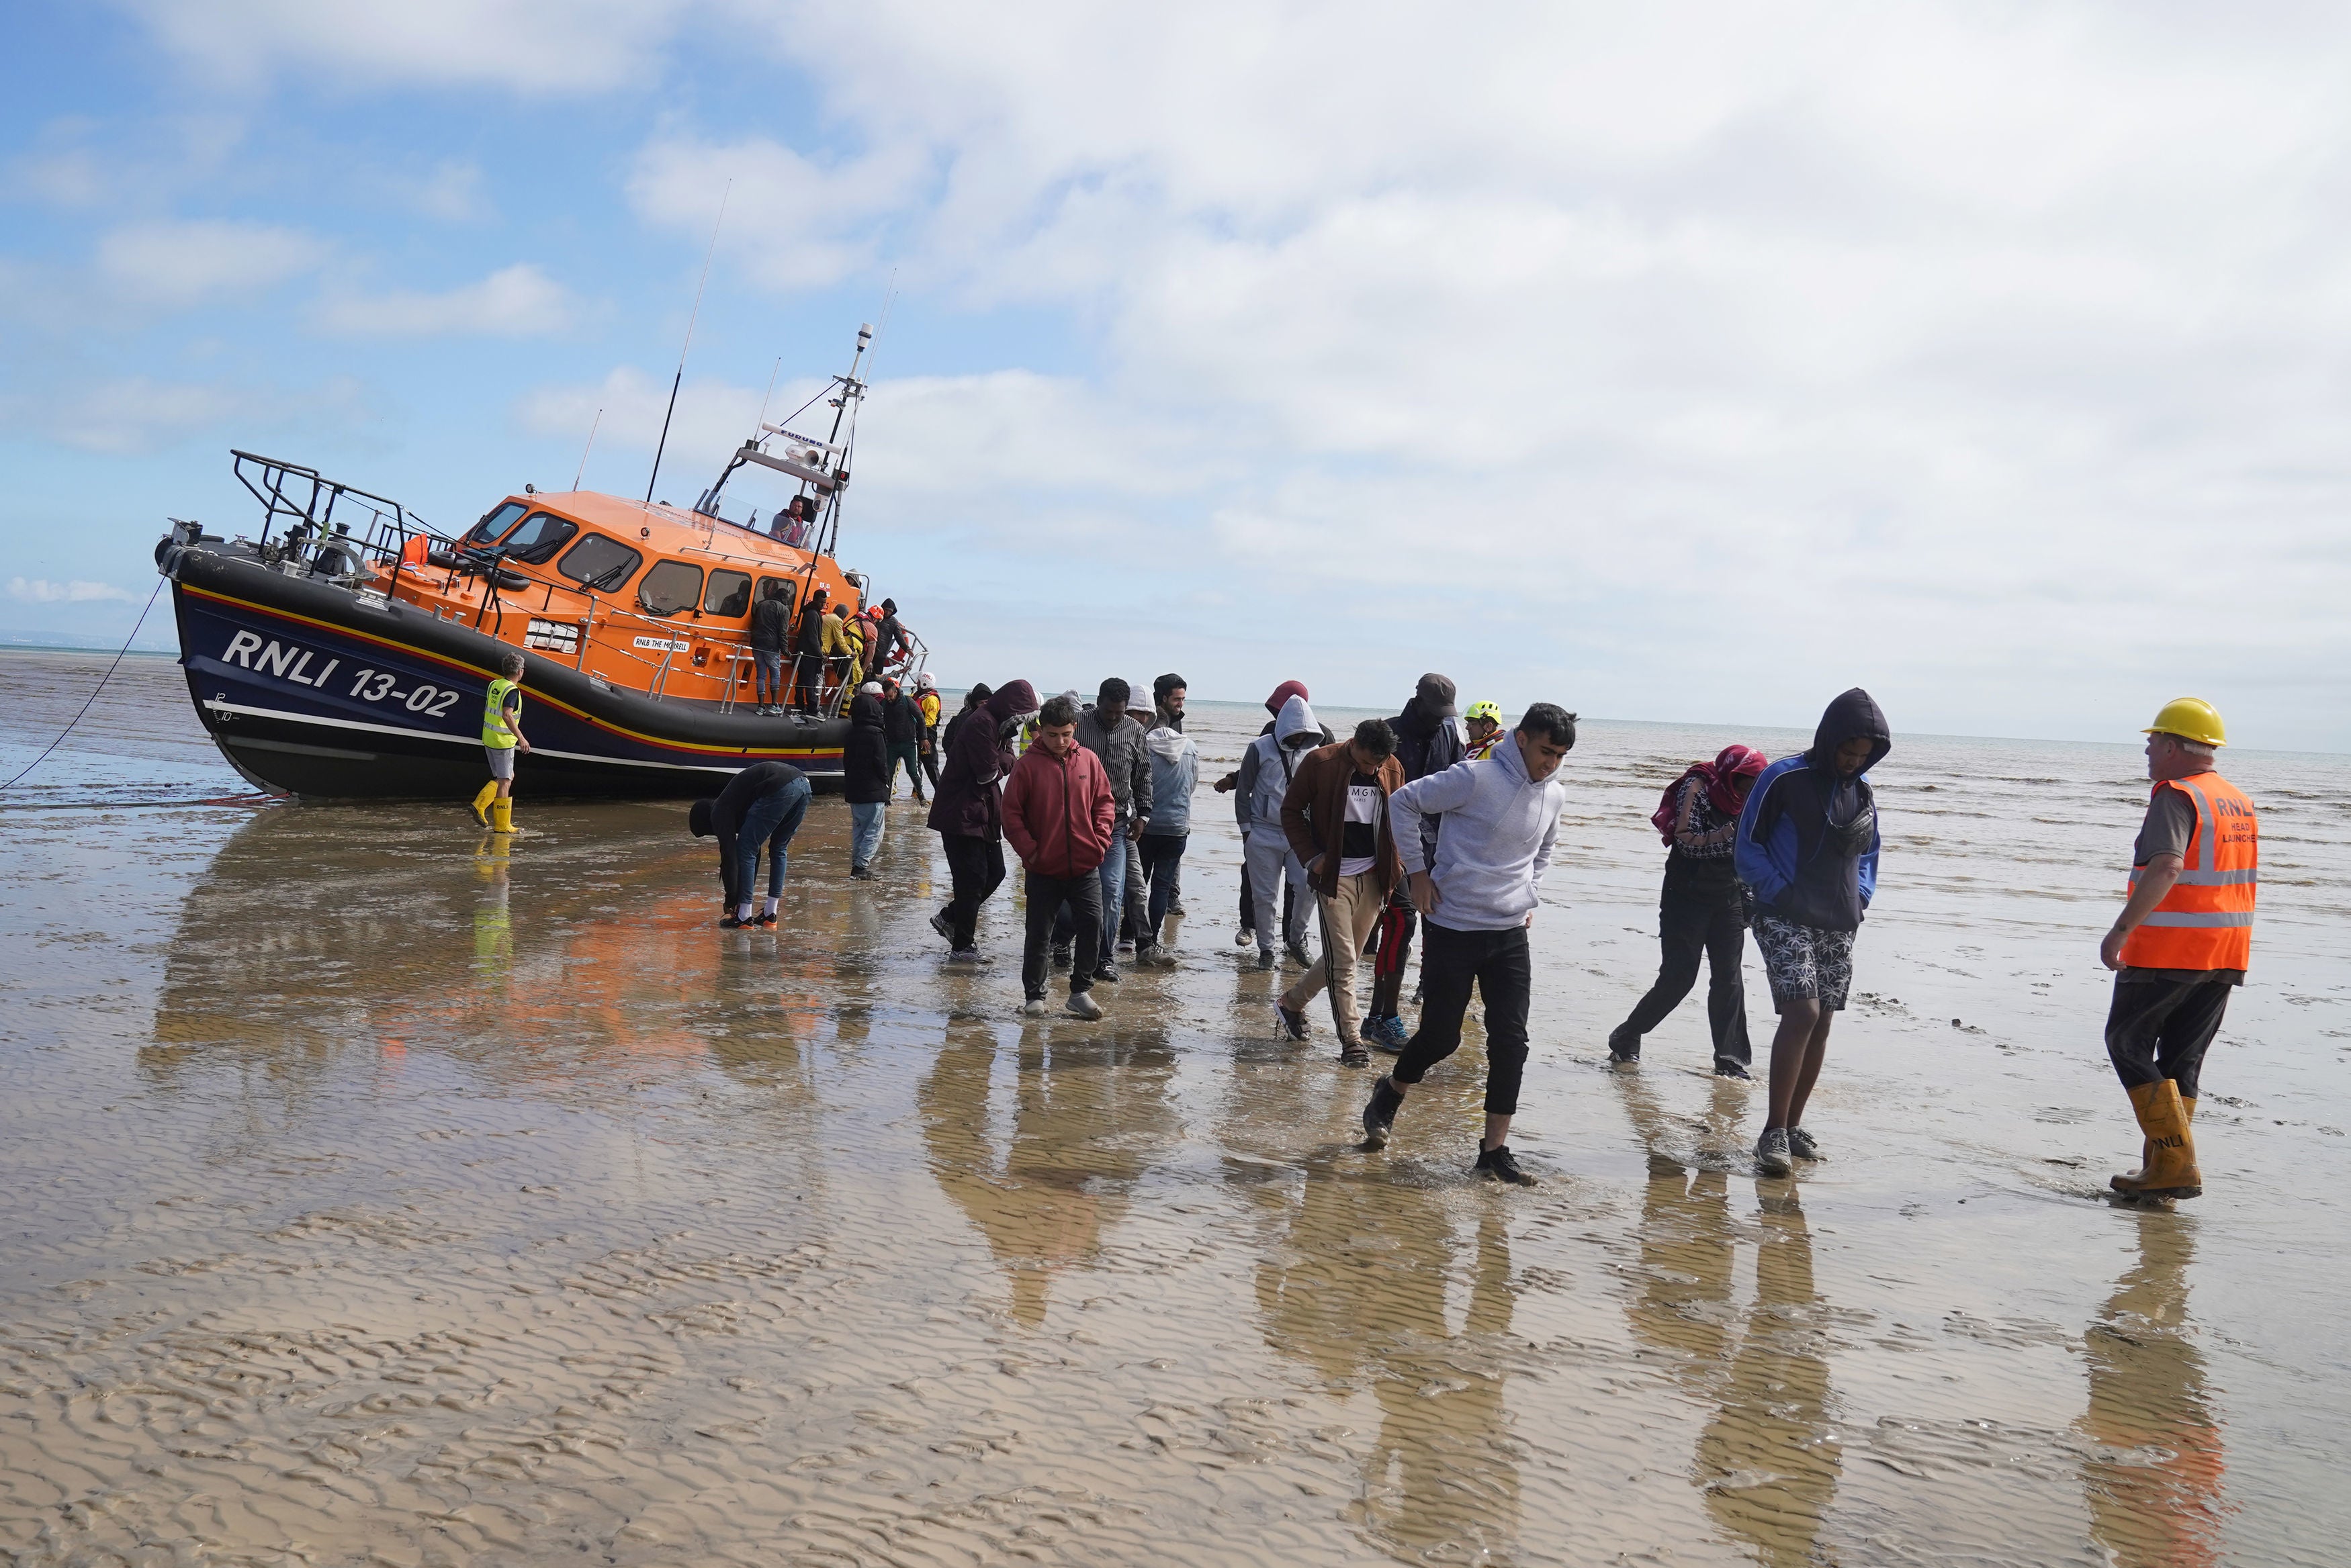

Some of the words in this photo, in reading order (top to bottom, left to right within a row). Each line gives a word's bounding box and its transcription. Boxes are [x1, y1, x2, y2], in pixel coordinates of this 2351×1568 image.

[781, 430, 823, 447] FURUNO
[635, 639, 650, 647] RNLB
[652, 640, 662, 648] THE
[664, 641, 686, 651] MORELL
[221, 630, 340, 688] RNLI
[349, 669, 459, 718] 13-02
[215, 692, 226, 703] 12
[221, 712, 232, 722] 10
[2231, 823, 2250, 832] HEAD
[2152, 1134, 2184, 1150] NLI
